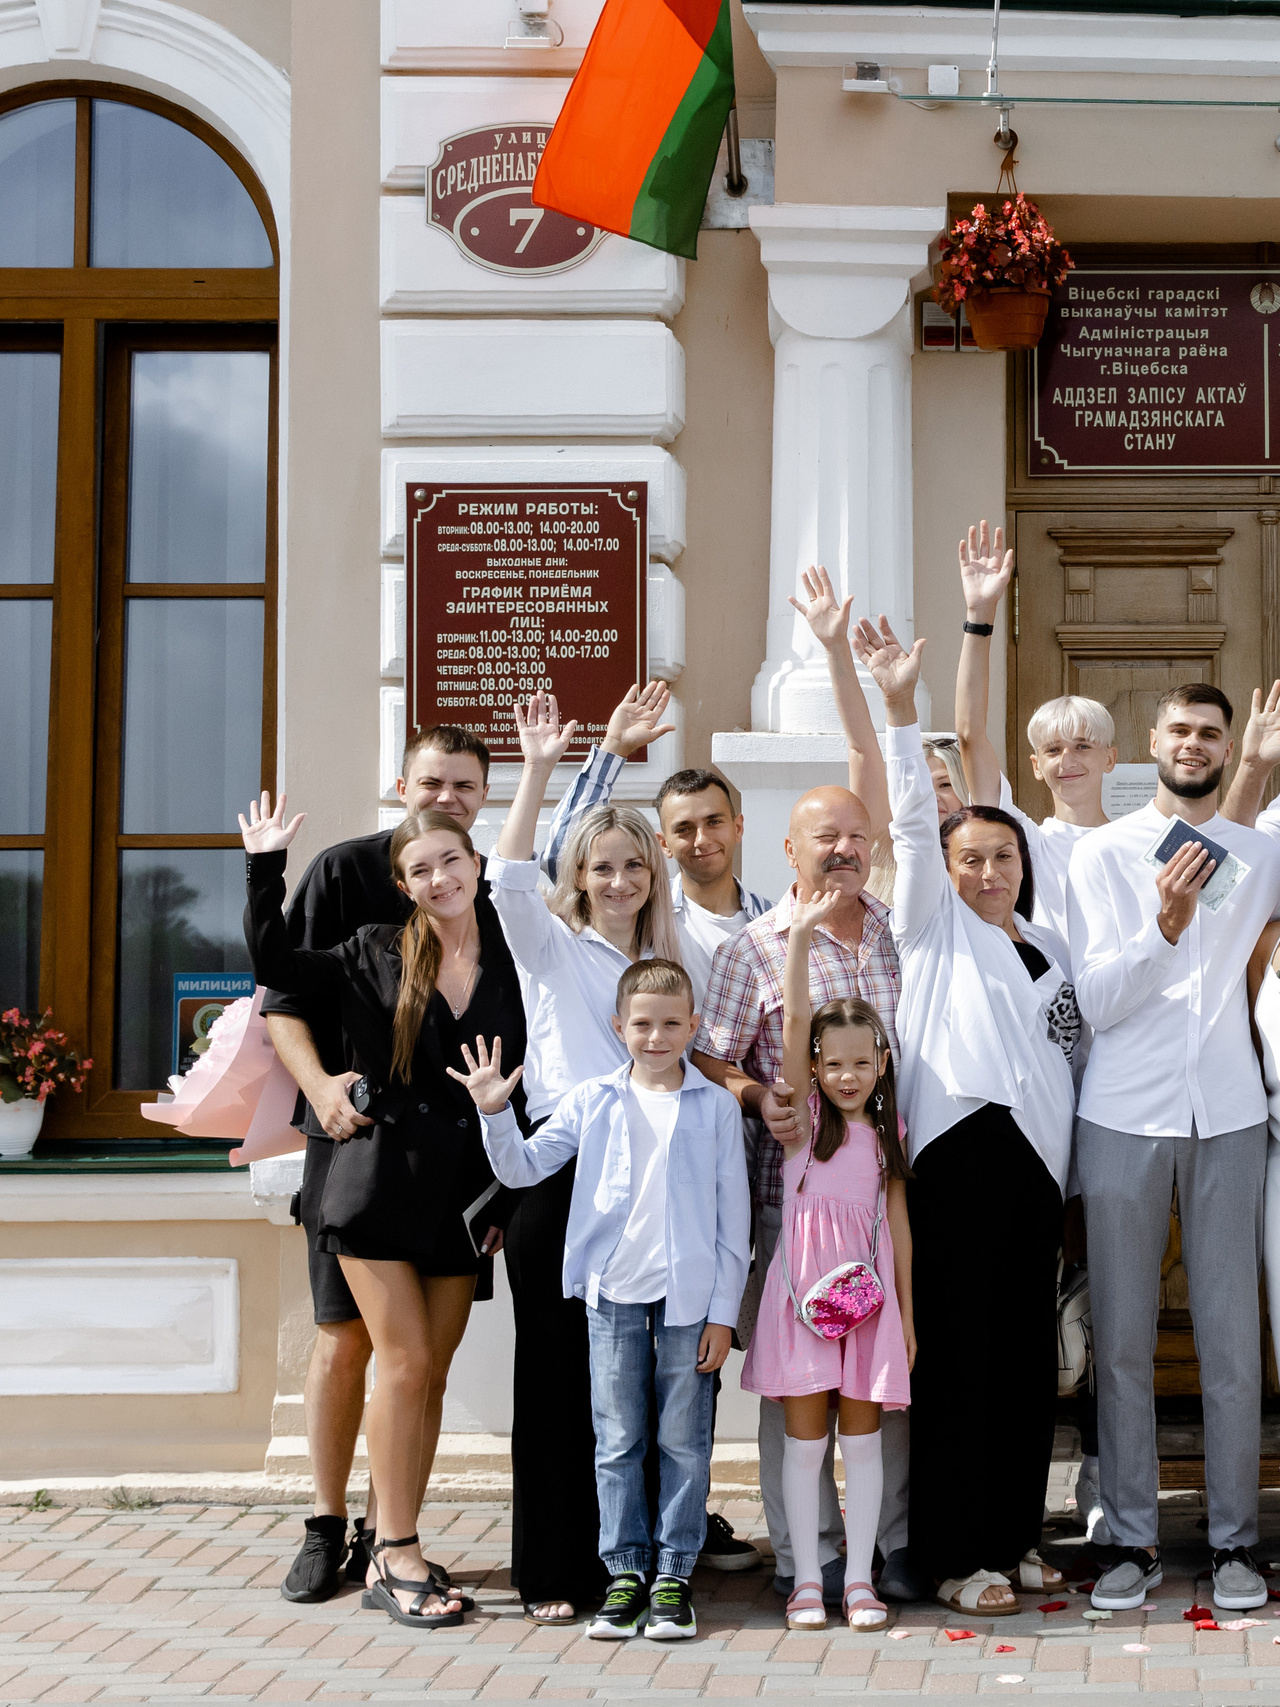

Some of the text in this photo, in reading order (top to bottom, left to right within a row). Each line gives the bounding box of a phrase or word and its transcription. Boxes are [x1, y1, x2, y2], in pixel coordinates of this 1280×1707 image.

[494, 131, 547, 150] улиц
[436, 152, 542, 200] СРЕДНЕНАБ
[509, 208, 544, 254] 7
[1068, 286, 1220, 302] Віцебскі гарадскі
[1061, 302, 1228, 321] выканаўчы камітэт
[1079, 325, 1209, 342] Адміністрацыя
[1060, 343, 1228, 361] Чыгуначнага раёна
[1100, 361, 1188, 377] г.Віцебска
[1053, 382, 1247, 407] АДДЗЕЛ ЗАПІСУ АКТАЎ
[1075, 410, 1225, 431] ГРАМАДЗЯНСКАГА
[1124, 433, 1176, 451] СТАНУ
[458, 502, 599, 516] РЕЖИМ РАБОТЫ:
[438, 521, 600, 536] ВТОРНИК: 08.00-13.00; 14.00-20.00
[493, 538, 557, 553] 08.00-13.00;
[563, 538, 620, 552] 14.00-17.00
[486, 557, 568, 568] ВЫХОДНЫЕ ДНИ:
[455, 569, 600, 580] ВОСКРЕСЕНЬЕ, ПОНЕДЕЛЬНИК
[463, 584, 592, 599] ГРАФИК ПРИЁМА
[446, 601, 609, 614] ЗАИНТЕРЕСОВАННЫХ
[509, 616, 545, 629] ЛИЦ:
[437, 629, 618, 645] ВТОРНИК: 11.00-13.00; 14.00-20.00
[437, 645, 610, 661] СРЕДА: 08.00-13.00; 14.00-17.00
[437, 662, 546, 675] ЧЕТВЕРГ: 08.00-13.00
[437, 677, 553, 692] ПЯТНИЦА: 08.00-09.00
[437, 697, 478, 707] СУББОТА:
[587, 722, 608, 733] брако
[178, 980, 252, 992] МИЛИЦИЯ
